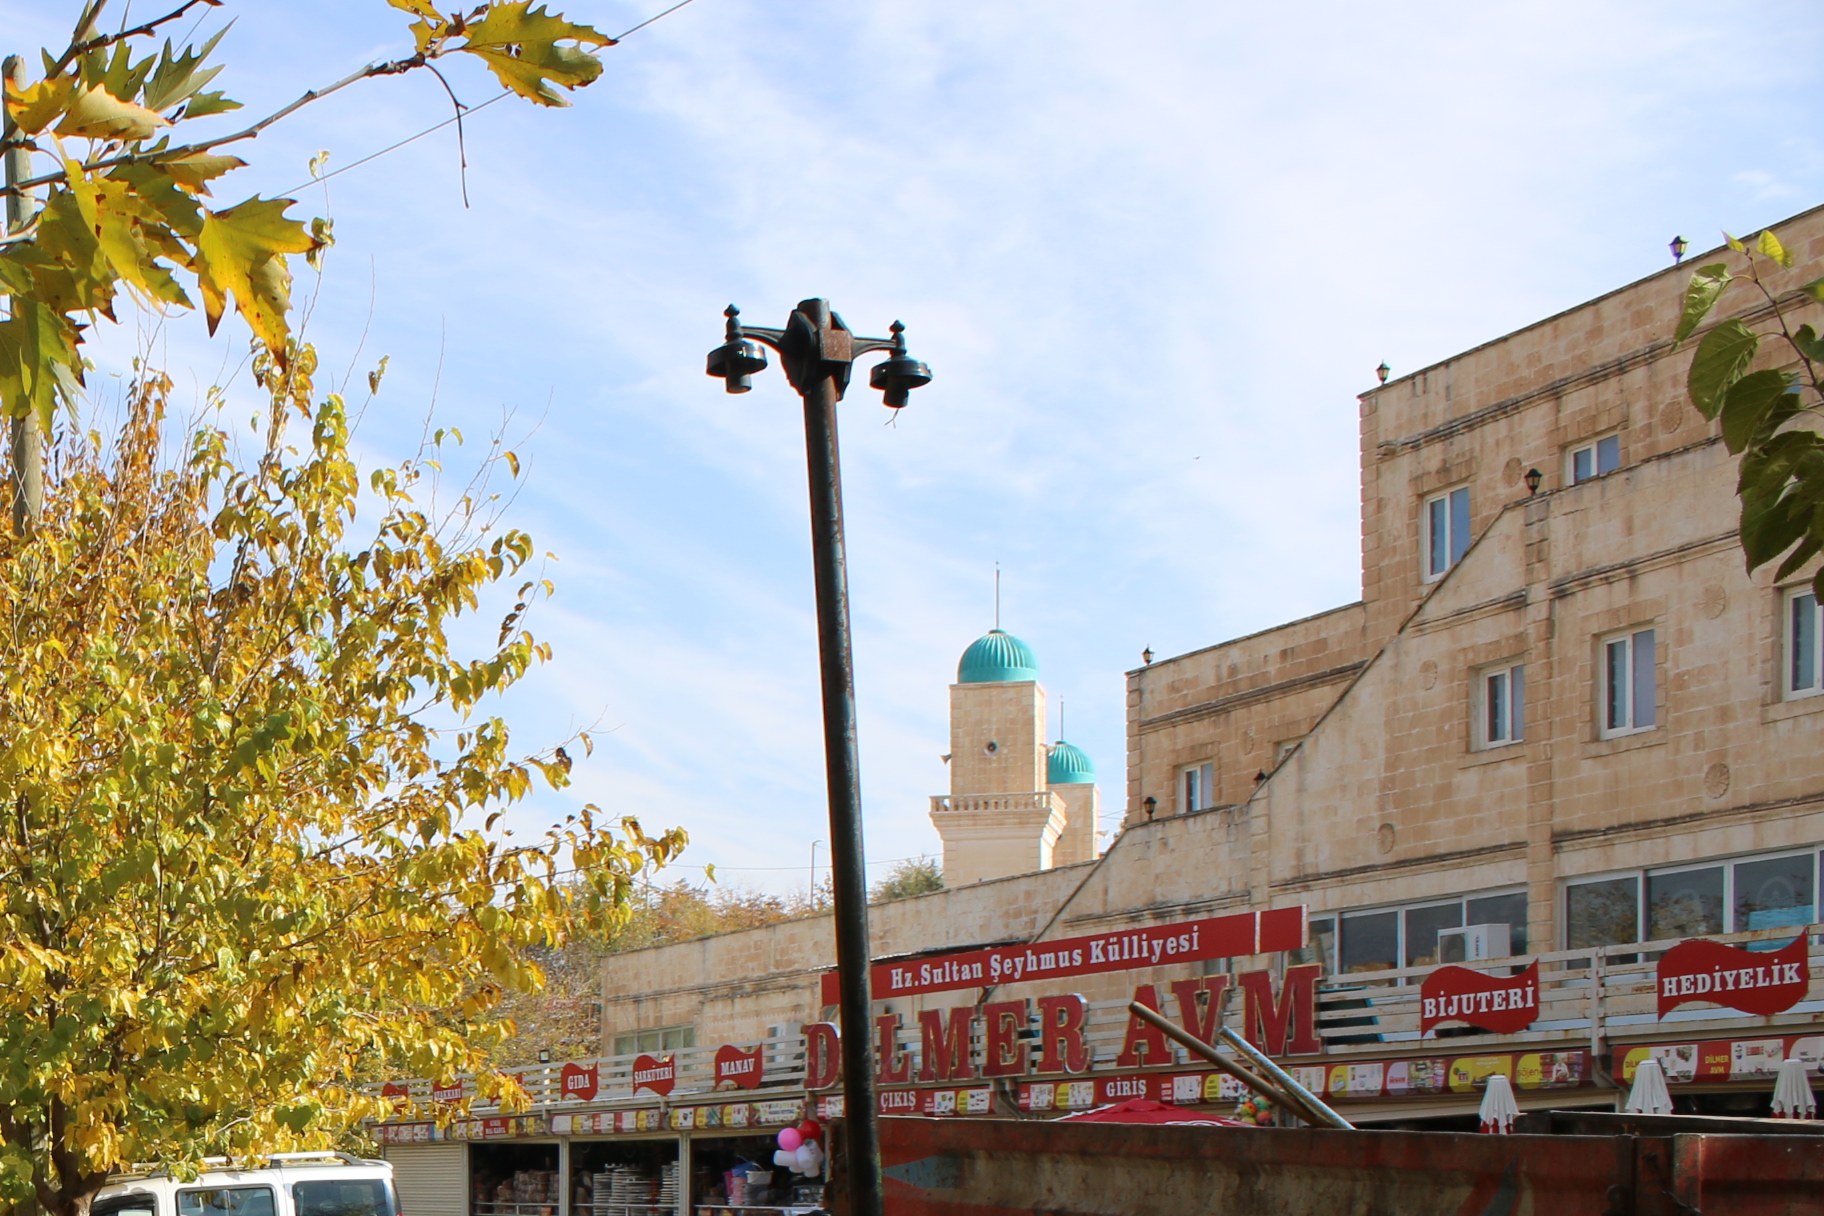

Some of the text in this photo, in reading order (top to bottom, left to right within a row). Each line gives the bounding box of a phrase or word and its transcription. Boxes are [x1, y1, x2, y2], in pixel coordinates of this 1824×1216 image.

[990, 948, 1082, 983] Şeyhmus
[1090, 925, 1200, 964] Külliyesi
[1662, 958, 1801, 997] HEDİYELİK
[1423, 979, 1535, 1018] BİJUTERİ
[802, 962, 1325, 1091] DLMER AVM
[721, 1058, 755, 1076] MANAV
[1705, 1054, 1729, 1064] DİLMER
[1710, 1066, 1725, 1074] AVM
[567, 1073, 590, 1090] GIDA
[634, 1062, 673, 1087] ŞARKÜTERİ
[1106, 1077, 1147, 1099] GİRİŞ
[880, 1091, 916, 1112] ÇIKIŞ
